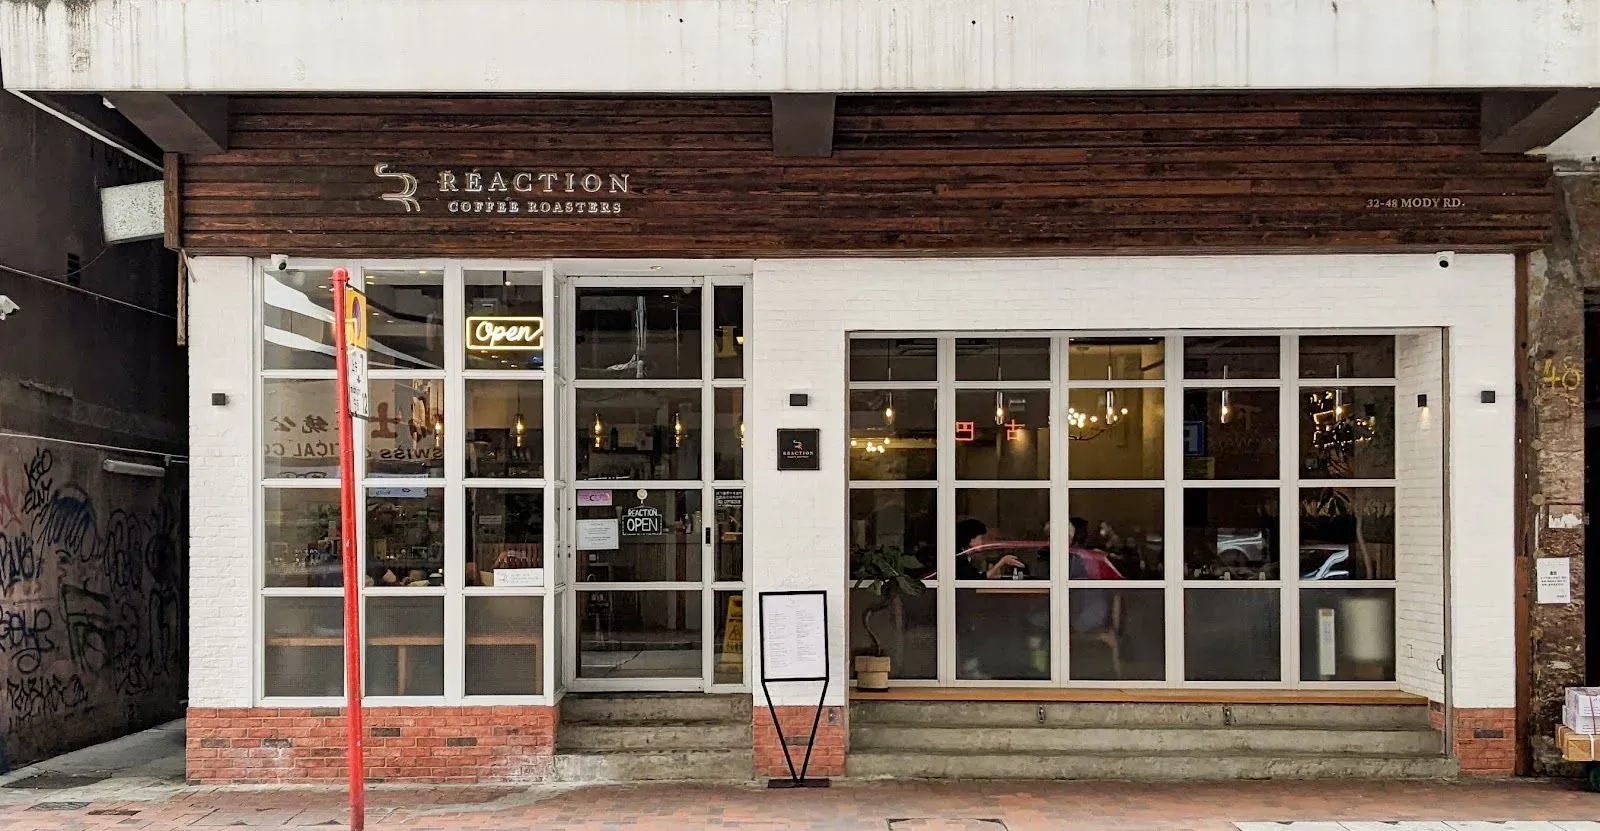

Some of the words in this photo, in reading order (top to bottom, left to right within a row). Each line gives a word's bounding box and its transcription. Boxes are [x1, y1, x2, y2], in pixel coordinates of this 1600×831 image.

[438, 171, 629, 193] REACTION
[448, 201, 519, 213] COFFEE
[528, 201, 621, 213] ROASTERS
[1366, 198, 1398, 208] 32-48
[1400, 197, 1440, 208] MODY
[1443, 197, 1465, 208] RD.
[475, 320, 538, 348] Open
[628, 508, 658, 517] REACTION
[627, 517, 658, 532] OPEN
